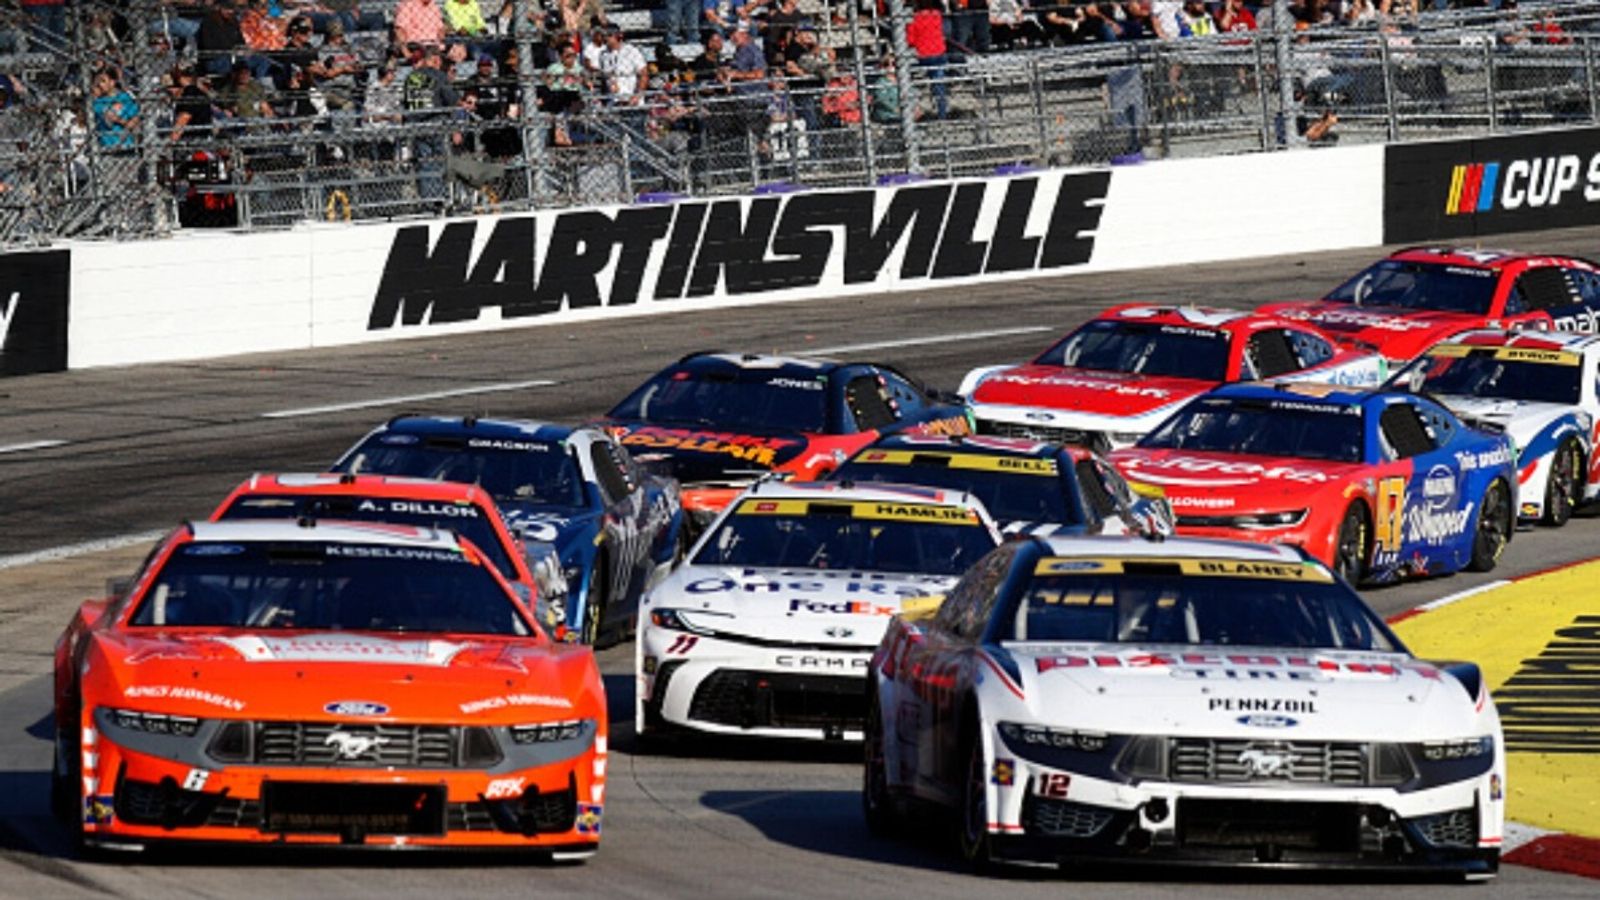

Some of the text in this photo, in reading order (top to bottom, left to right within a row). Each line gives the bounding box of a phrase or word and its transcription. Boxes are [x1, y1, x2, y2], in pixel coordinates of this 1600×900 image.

[1501, 154, 1580, 209] CUP
[367, 171, 1112, 331] MARTINSVILLE
[767, 377, 824, 391] JONES
[468, 438, 550, 452] GRAGSON
[998, 458, 1047, 471] BELL
[358, 500, 478, 518] A. DILLON
[876, 505, 970, 520] HAMLIN
[1199, 561, 1304, 577] BLANEY
[790, 599, 894, 616] FedEx
[667, 634, 699, 654] 11
[776, 655, 869, 669] CAMR
[1208, 698, 1319, 713] PENNZOIL
[183, 767, 210, 792] 6
[1038, 772, 1071, 797] 12
